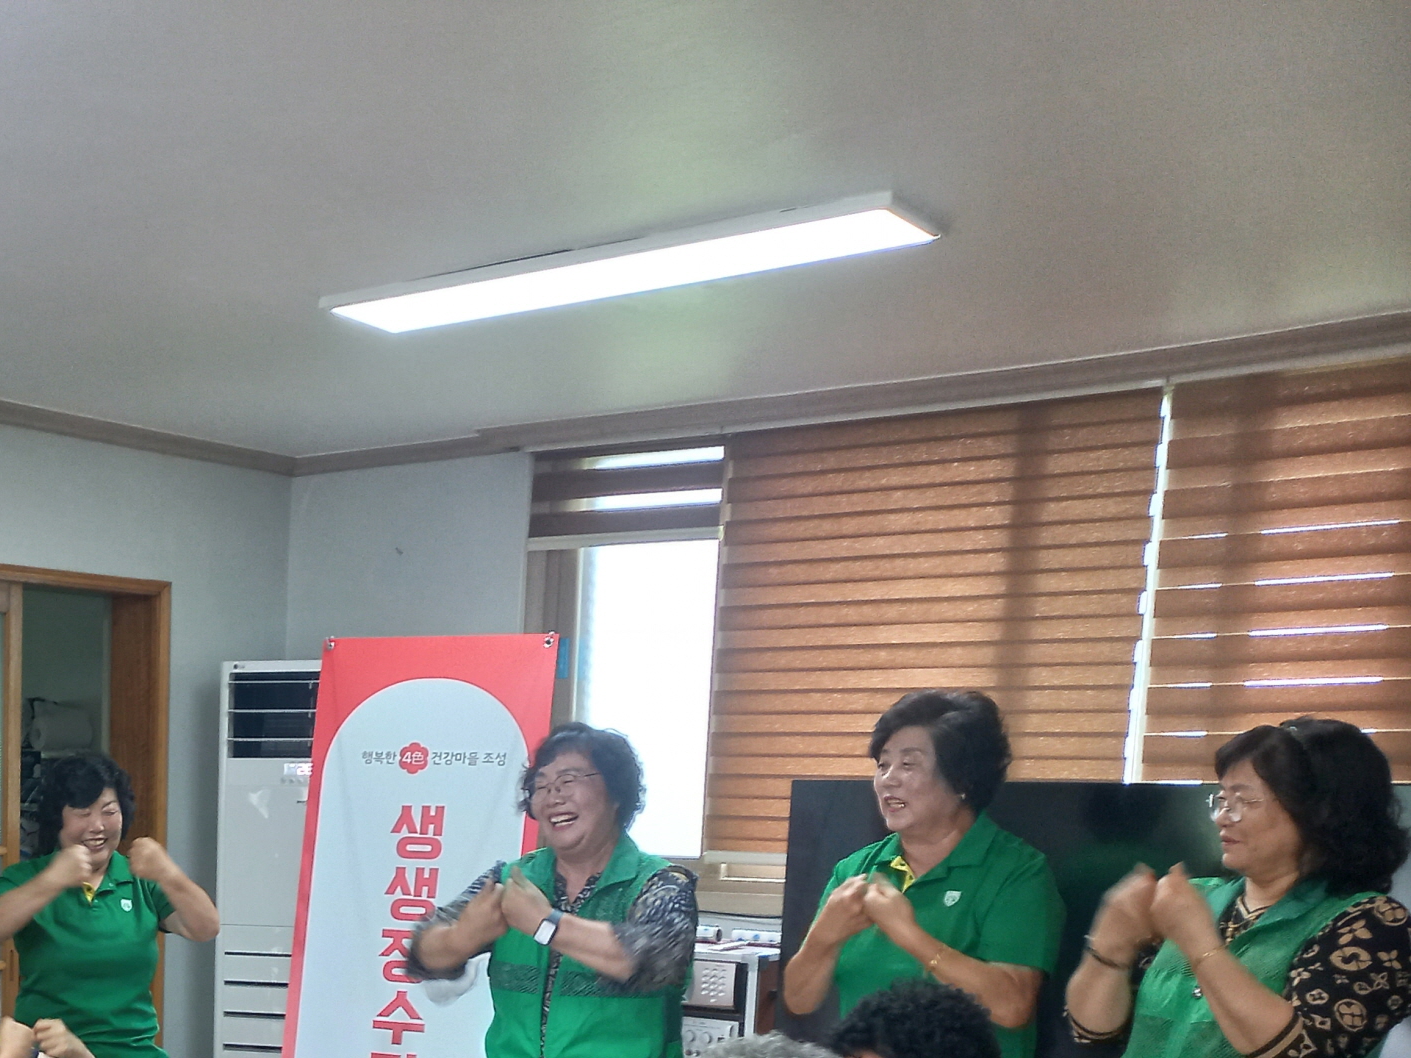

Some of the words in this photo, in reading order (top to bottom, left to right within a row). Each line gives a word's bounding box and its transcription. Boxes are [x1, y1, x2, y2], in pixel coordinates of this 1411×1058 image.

[361, 750, 398, 765] 행복한
[431, 751, 479, 766] 건강마을
[482, 751, 507, 767] 조성
